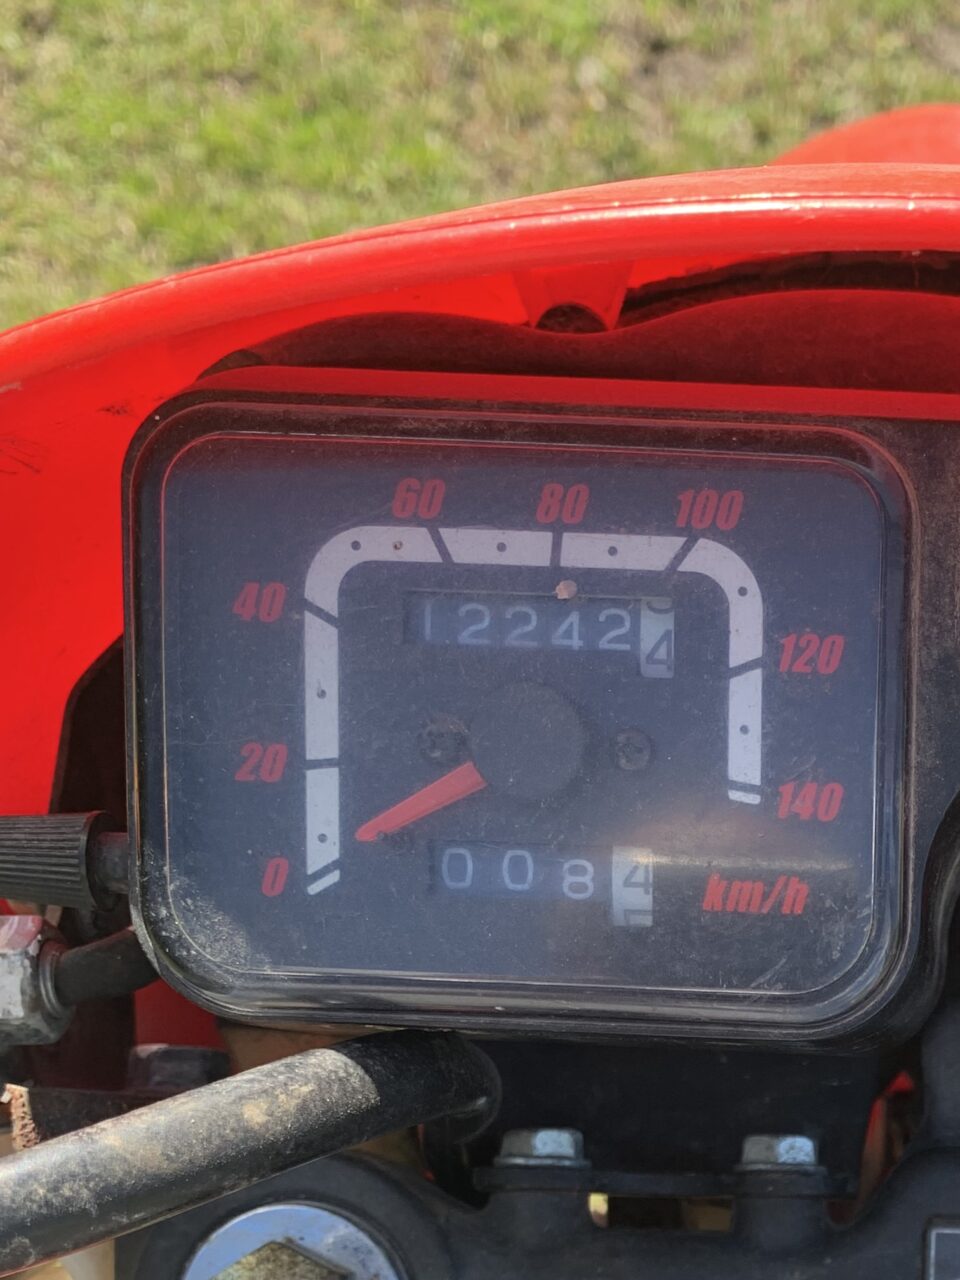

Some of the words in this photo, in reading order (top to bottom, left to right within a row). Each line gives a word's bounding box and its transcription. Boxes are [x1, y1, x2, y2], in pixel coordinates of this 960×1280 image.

[391, 478, 446, 520] 60
[536, 484, 589, 524] 80
[676, 489, 744, 530] 100
[234, 582, 288, 623] 40
[779, 634, 845, 675] 120
[234, 743, 288, 782] 20
[777, 782, 844, 822] 140
[261, 857, 290, 898] 0
[702, 871, 810, 916] km/h
